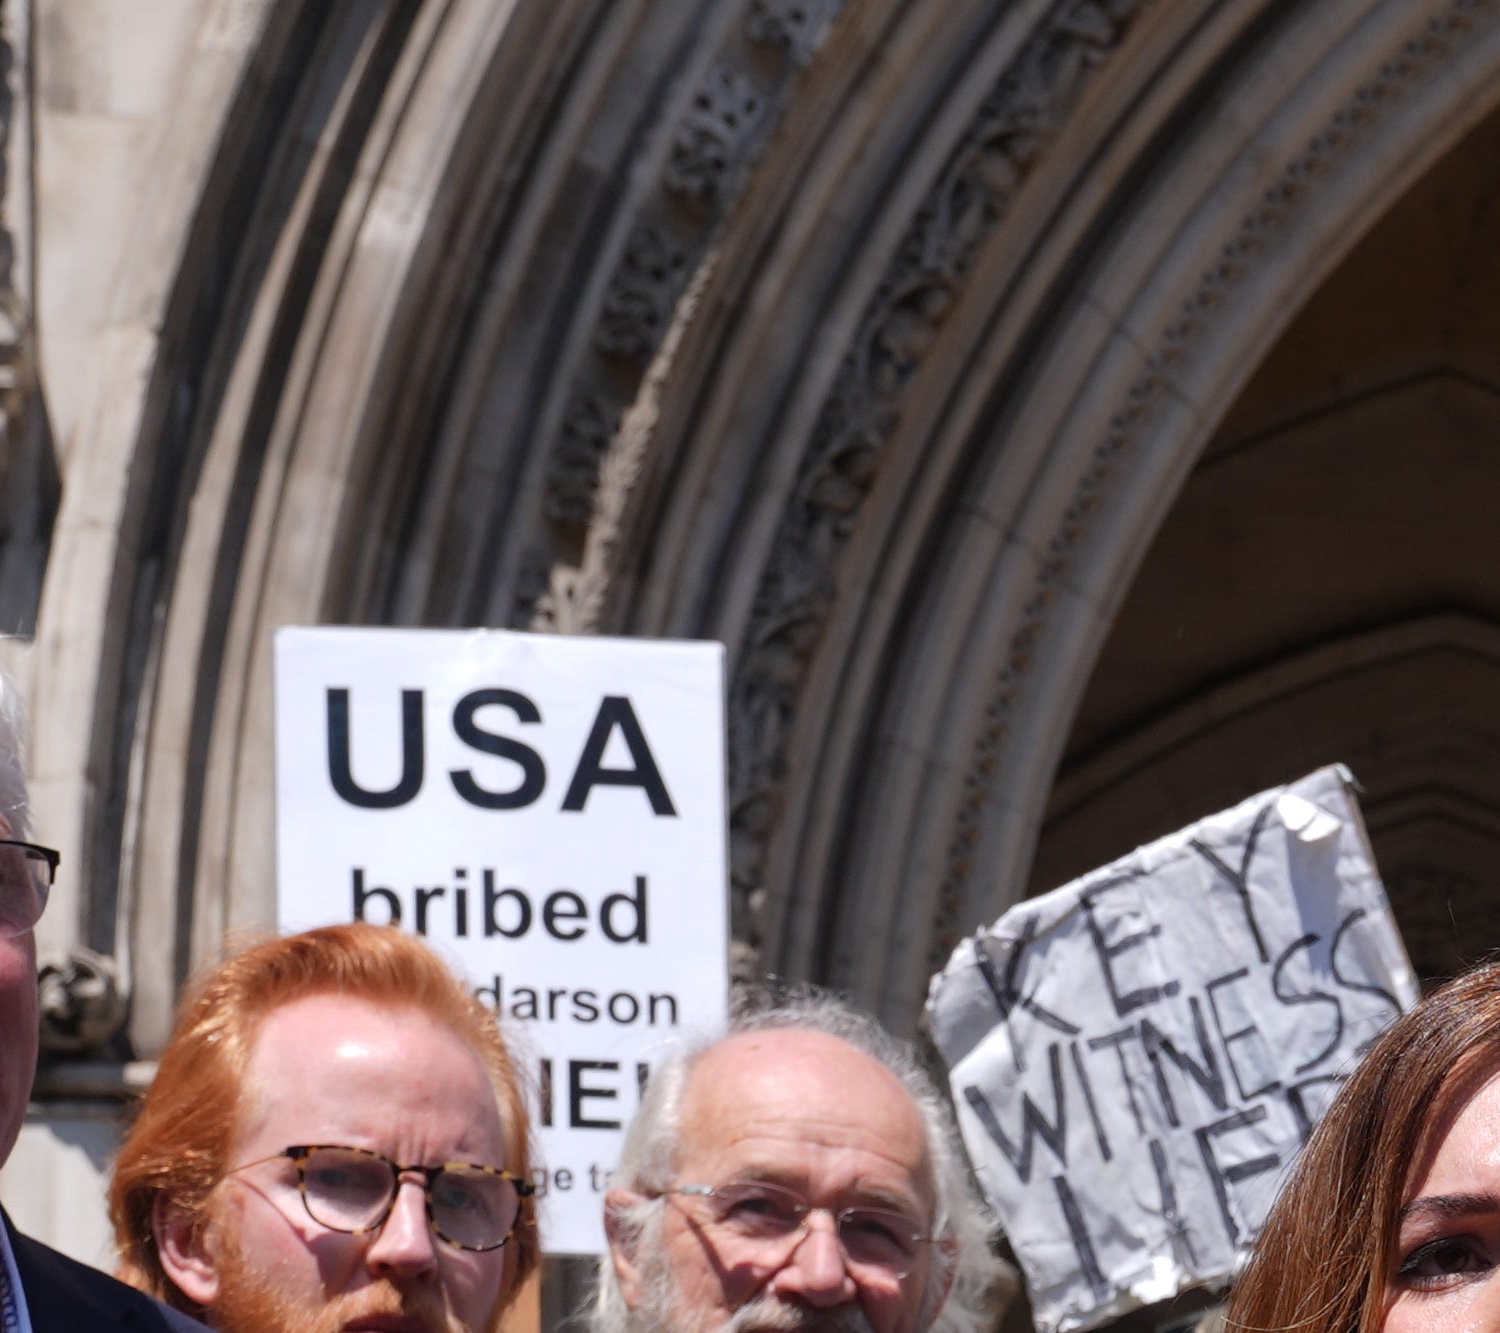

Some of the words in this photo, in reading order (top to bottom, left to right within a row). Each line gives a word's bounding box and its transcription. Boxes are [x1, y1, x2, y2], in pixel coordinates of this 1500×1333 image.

[324, 686, 679, 818] USA
[351, 867, 650, 945] bribed
[975, 804, 1279, 1073] KEY
[477, 975, 679, 1027] darson
